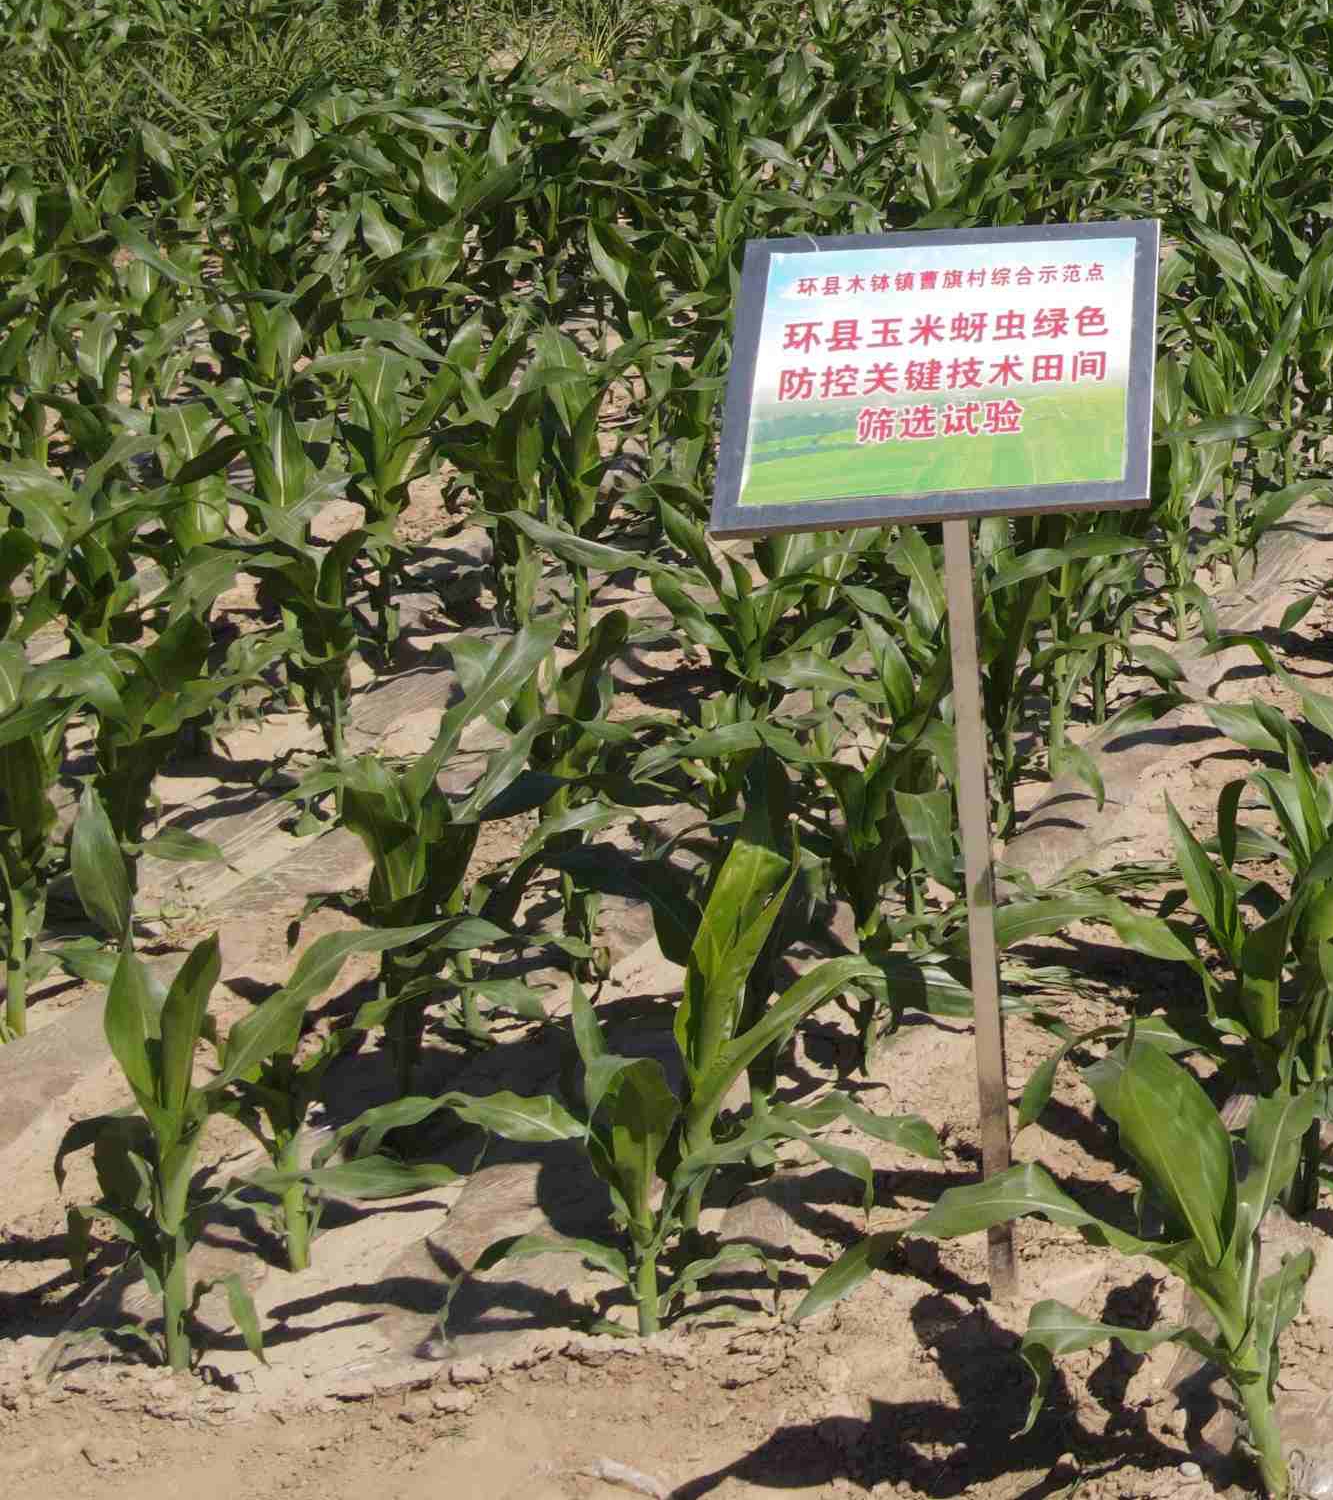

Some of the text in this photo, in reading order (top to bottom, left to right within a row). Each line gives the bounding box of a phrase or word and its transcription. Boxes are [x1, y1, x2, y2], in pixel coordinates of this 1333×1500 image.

[797, 262, 1105, 296] 环县木钵镇曹旗村综合示范点
[782, 306, 1109, 355] 环县玉米蚜虫绿色
[778, 351, 1107, 400] 防控关键技术田间
[857, 400, 1023, 443] 筛选试验
